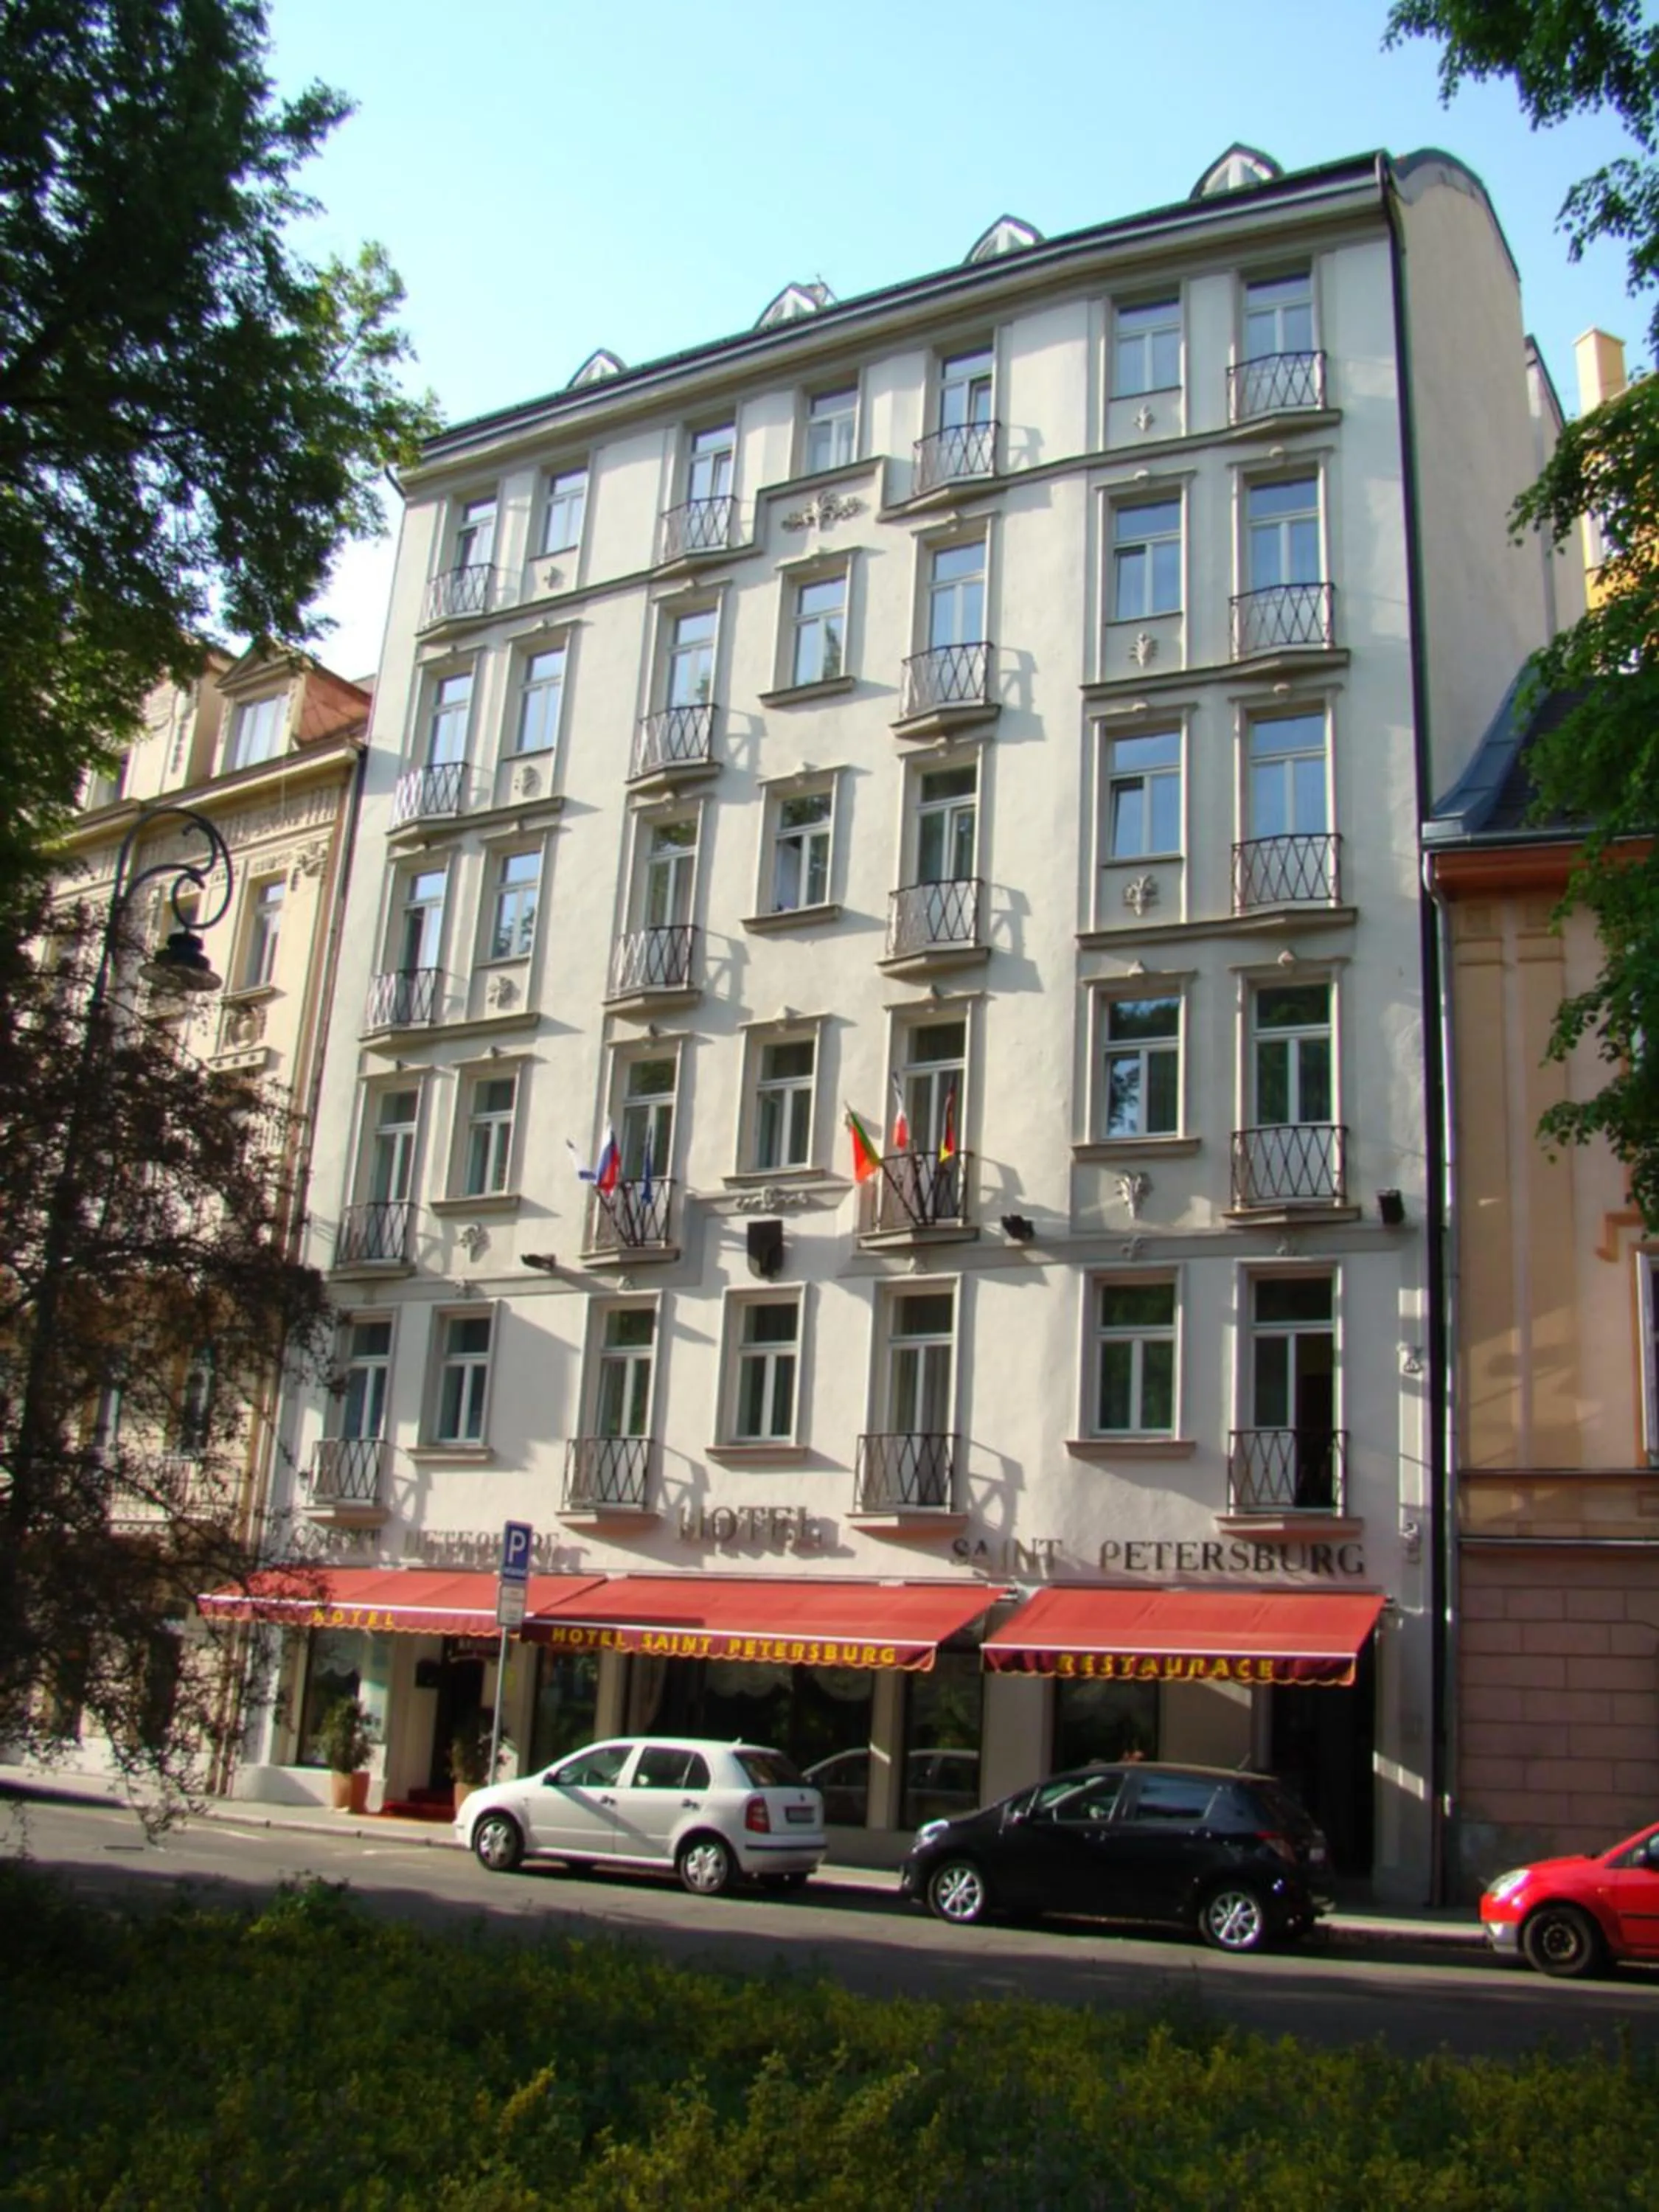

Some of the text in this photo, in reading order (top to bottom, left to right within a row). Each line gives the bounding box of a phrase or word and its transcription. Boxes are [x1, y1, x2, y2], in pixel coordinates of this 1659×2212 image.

[678, 1506, 823, 1547] HOTEL
[507, 1529, 526, 1564] P
[951, 1537, 1365, 1575] SAINT PETERSBURG
[553, 1627, 897, 1664] HOTEL SAINT PETERSBURG
[1057, 1653, 1275, 1679] RESTAURACE
